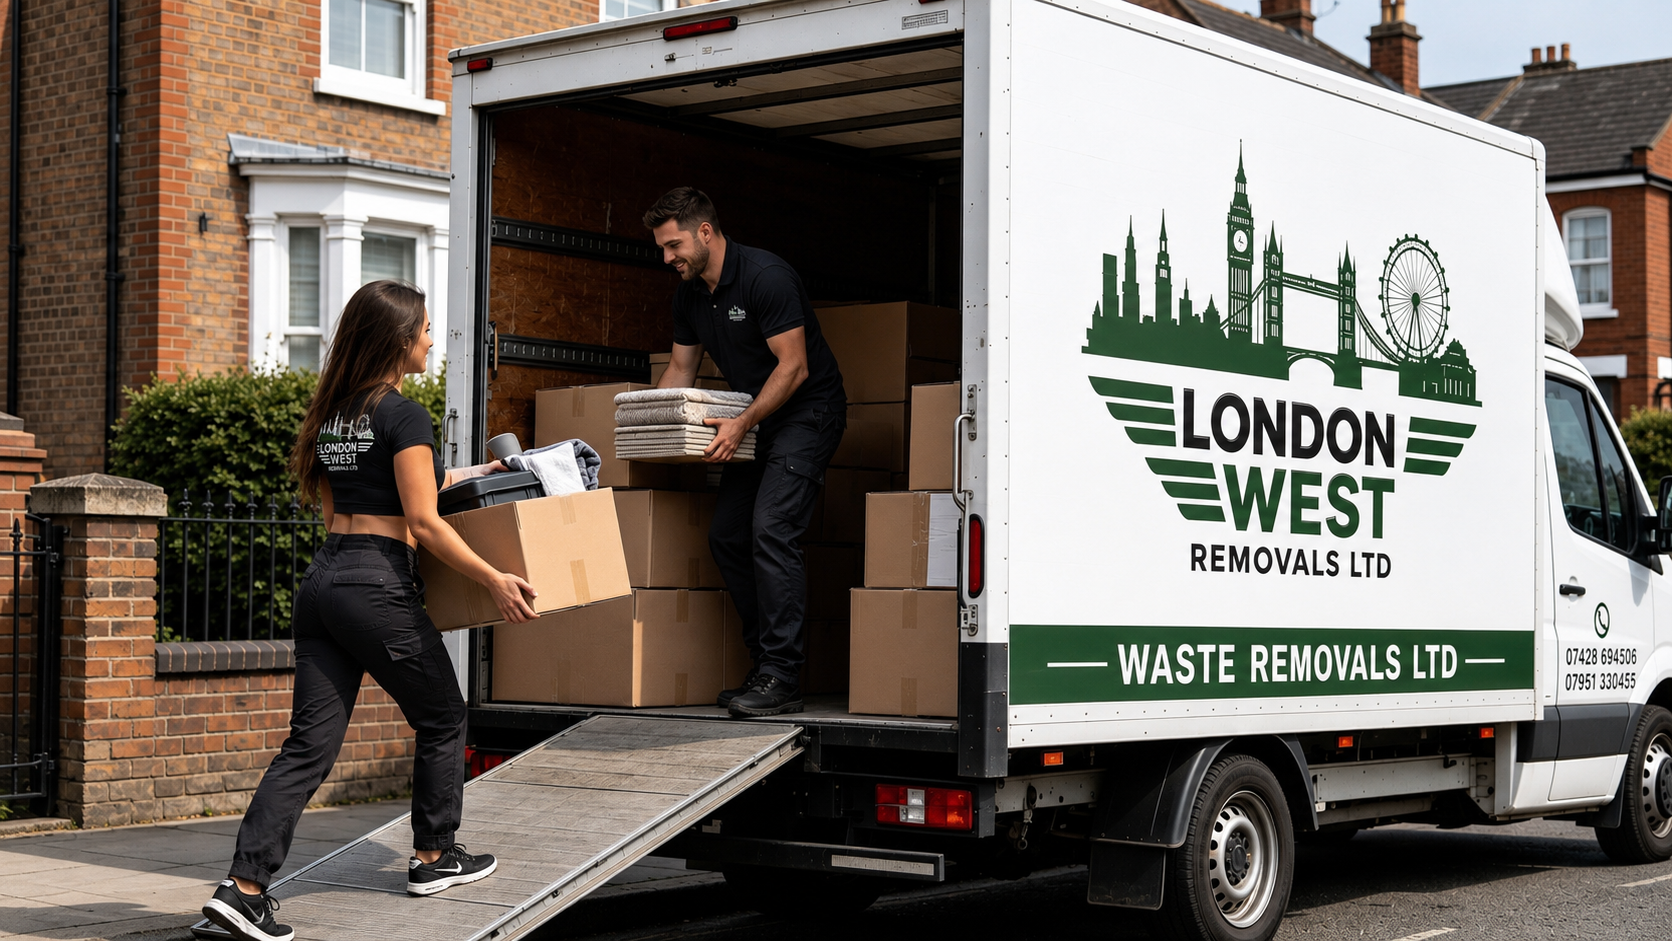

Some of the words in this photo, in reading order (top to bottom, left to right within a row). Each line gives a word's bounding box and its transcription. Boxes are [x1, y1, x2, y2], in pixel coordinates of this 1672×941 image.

[1183, 387, 1395, 468] LONDON
[320, 442, 357, 454] LONDON
[330, 453, 357, 464] WEST
[1223, 463, 1395, 539] WEST
[1190, 543, 1340, 577] REMOVALS
[1350, 551, 1392, 578] LTD
[1117, 643, 1236, 685] WASTE
[1250, 644, 1401, 683] REMOVALS
[1413, 644, 1458, 679] LTD
[1565, 647, 1598, 666] 07428
[1600, 647, 1637, 666] 694506
[1565, 672, 1596, 691] 07951
[1599, 672, 1636, 690] 330455
